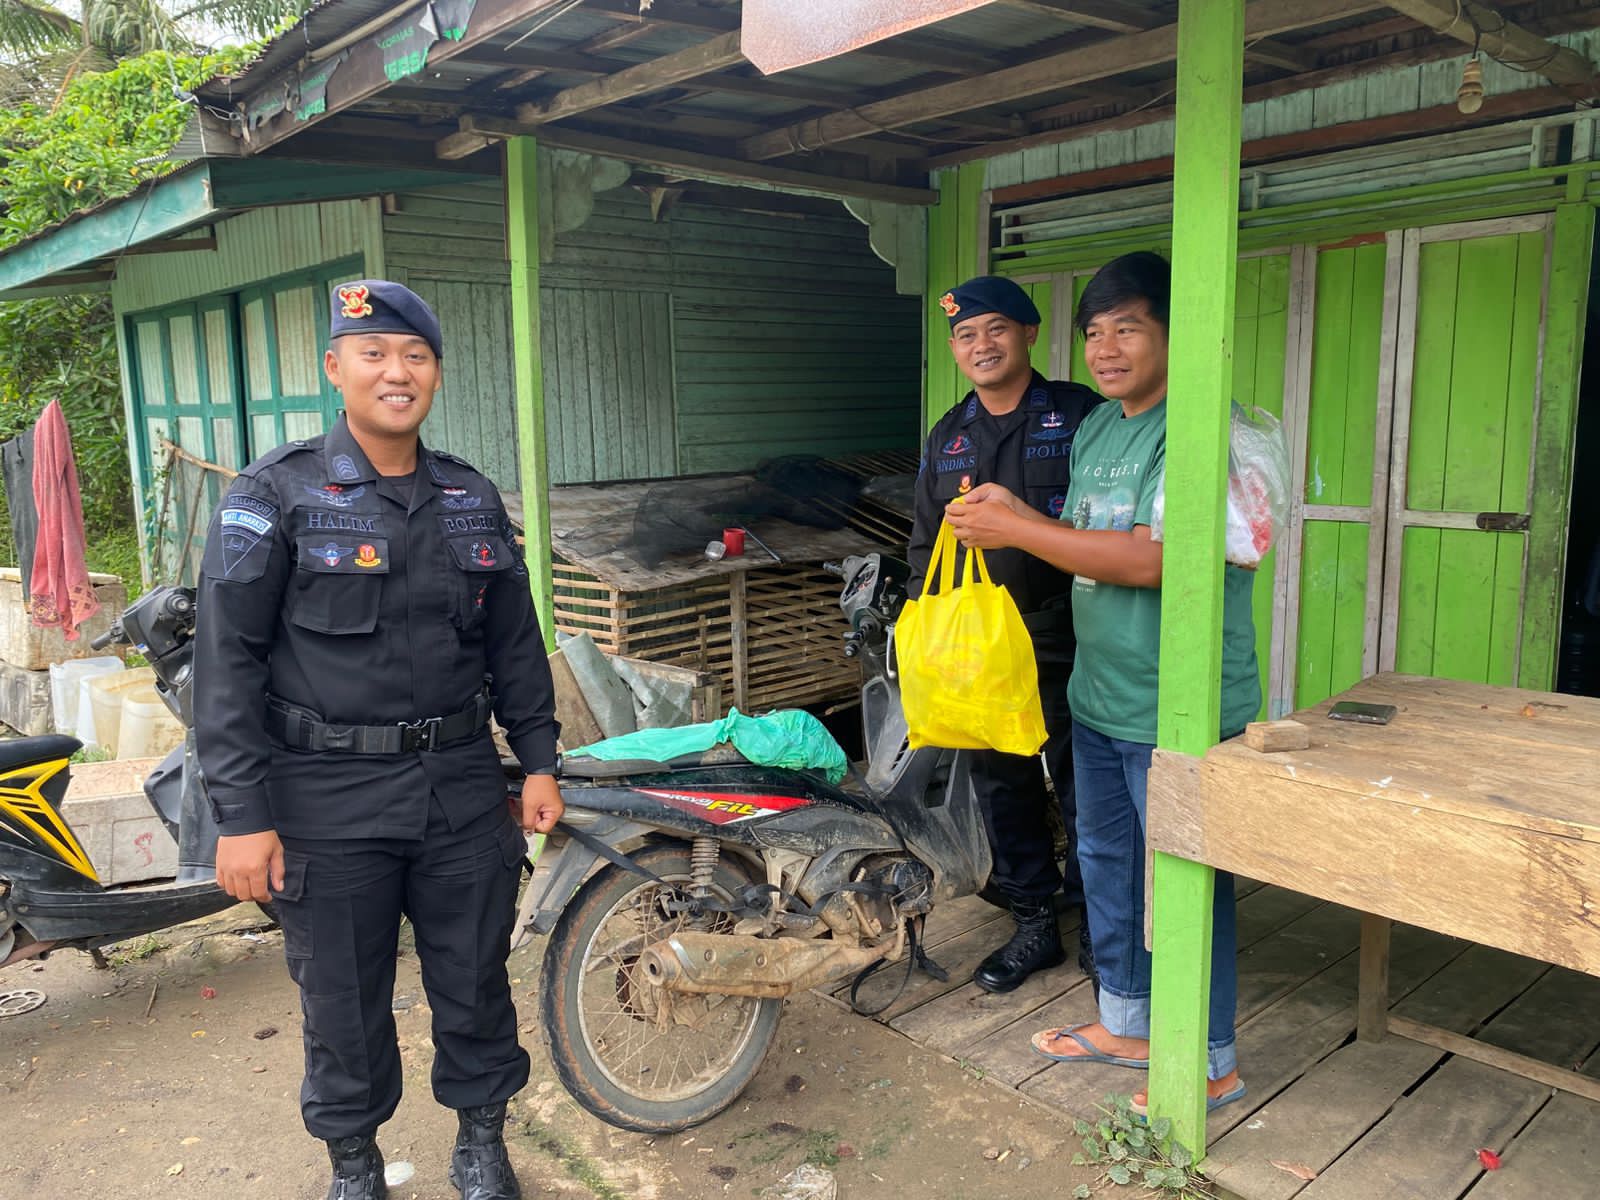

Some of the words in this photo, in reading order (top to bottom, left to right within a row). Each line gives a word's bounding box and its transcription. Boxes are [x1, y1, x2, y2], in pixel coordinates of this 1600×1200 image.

[306, 512, 377, 532] HALIM
[445, 516, 496, 532] POLRI
[706, 800, 758, 815] Fit
